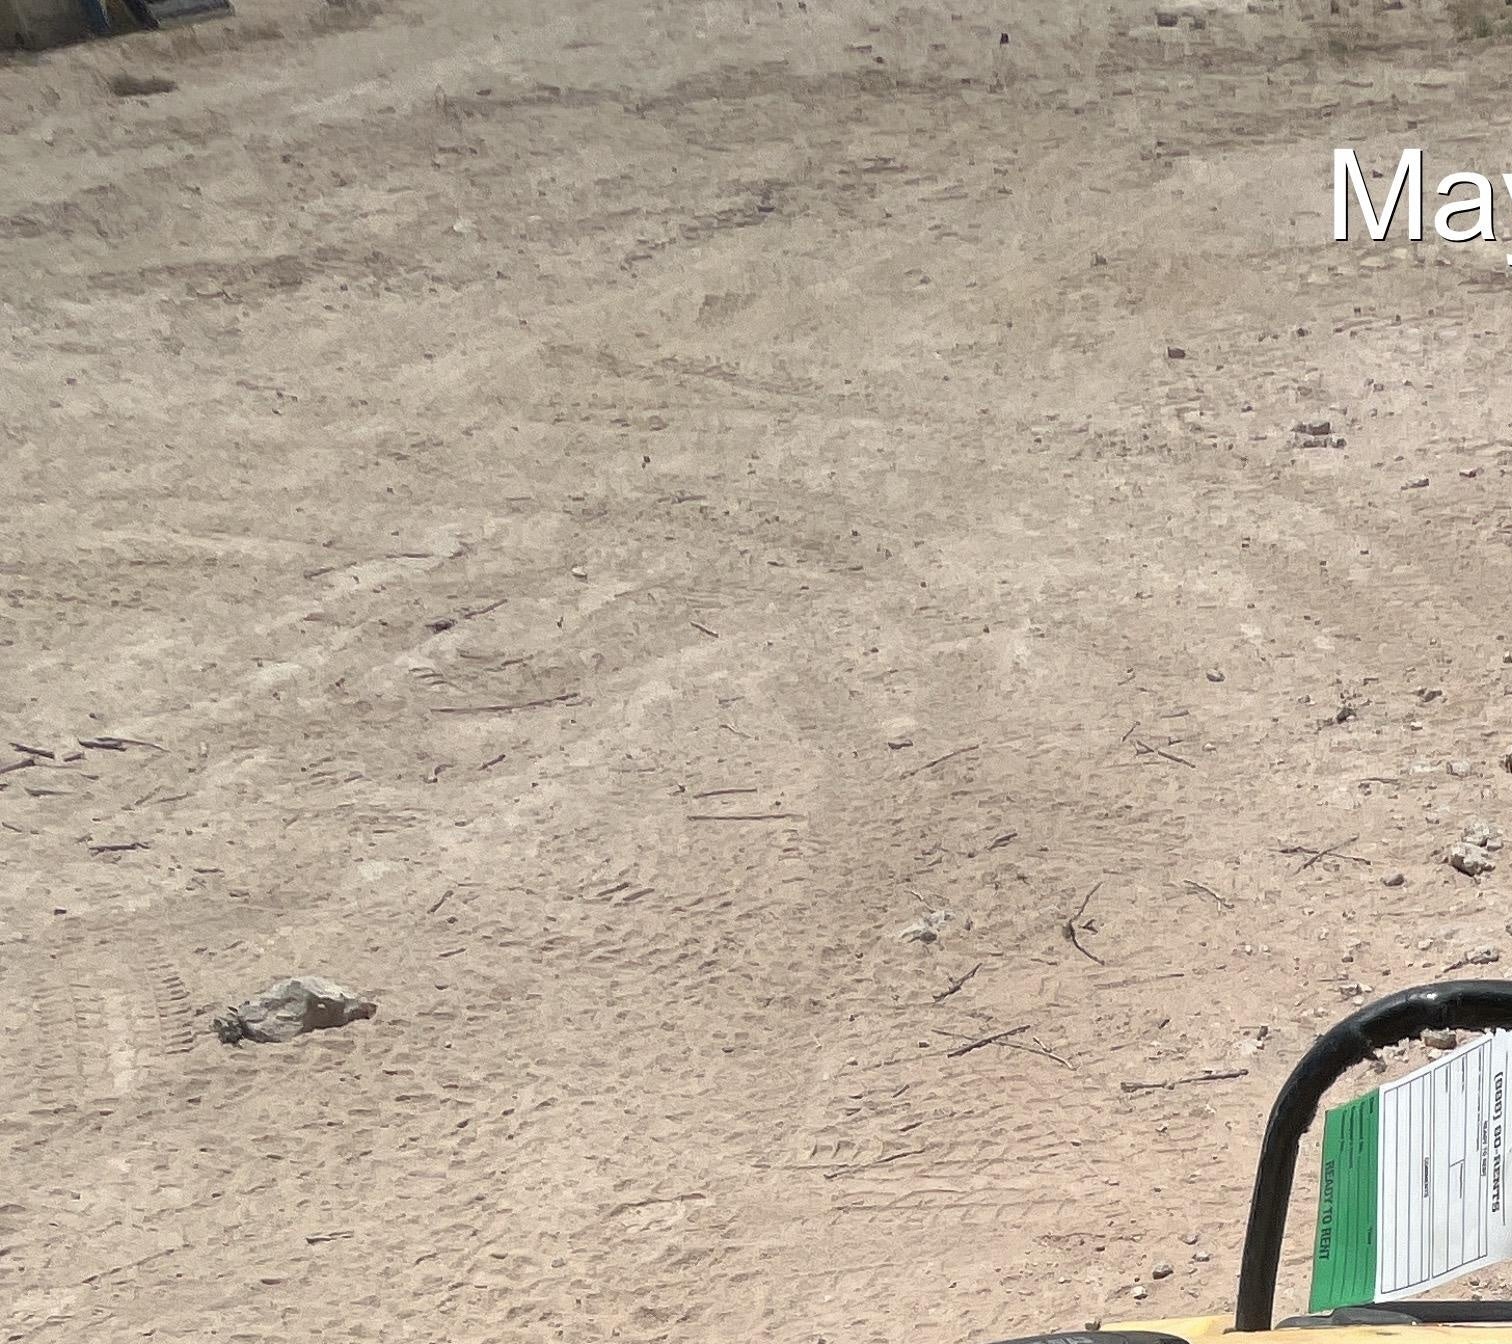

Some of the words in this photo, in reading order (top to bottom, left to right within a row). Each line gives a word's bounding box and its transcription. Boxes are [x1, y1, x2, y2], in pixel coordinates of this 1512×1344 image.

[1324, 1159, 1335, 1200] READY
[1321, 1205, 1333, 1225] TO
[1318, 1228, 1332, 1260] RENT
